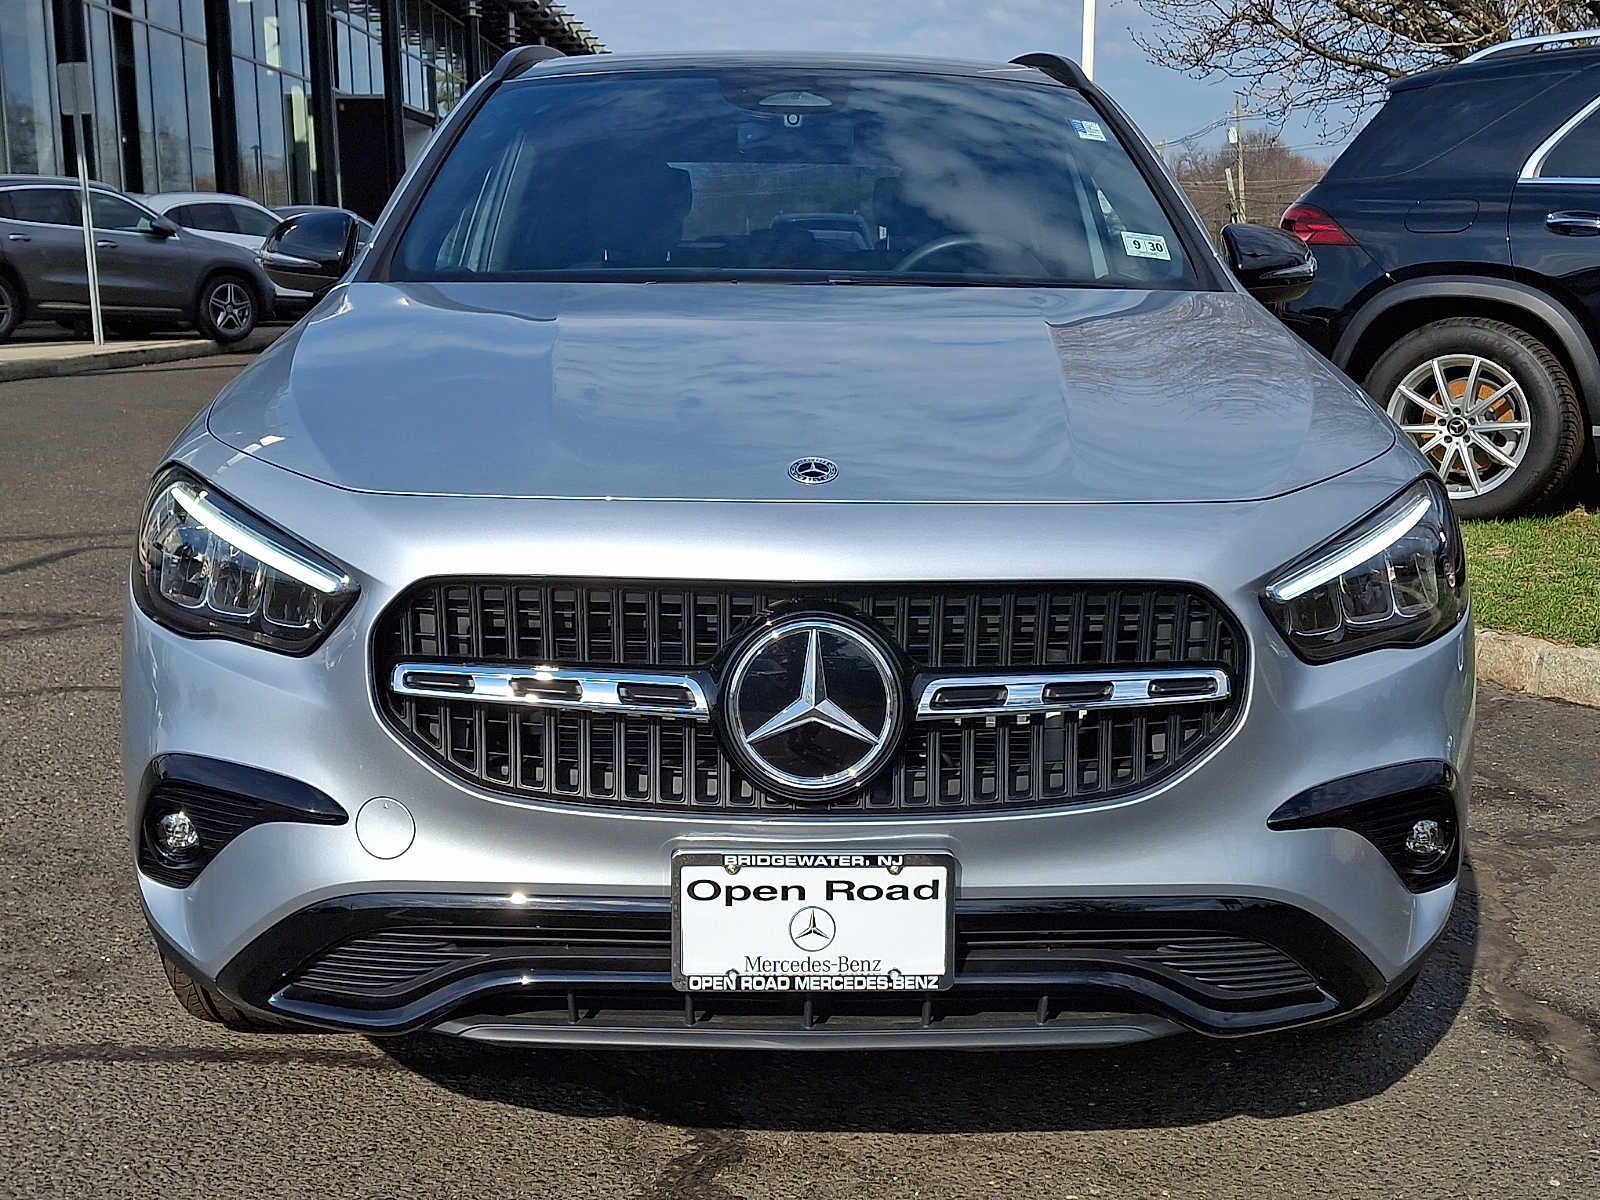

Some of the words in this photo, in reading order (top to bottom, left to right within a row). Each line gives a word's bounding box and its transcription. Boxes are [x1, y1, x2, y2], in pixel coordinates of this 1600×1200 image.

[1133, 240, 1141, 249] 9
[1149, 242, 1163, 252] 30
[724, 855, 870, 867] BRIDGEWATER,
[878, 855, 903, 867] NJ
[687, 879, 806, 907] Open
[825, 879, 940, 901] Road
[744, 955, 882, 973] Mercedes-Benz
[689, 976, 737, 991] OPEN
[740, 976, 789, 990] ROAD
[794, 975, 939, 990] MERCEDES-BENZ
